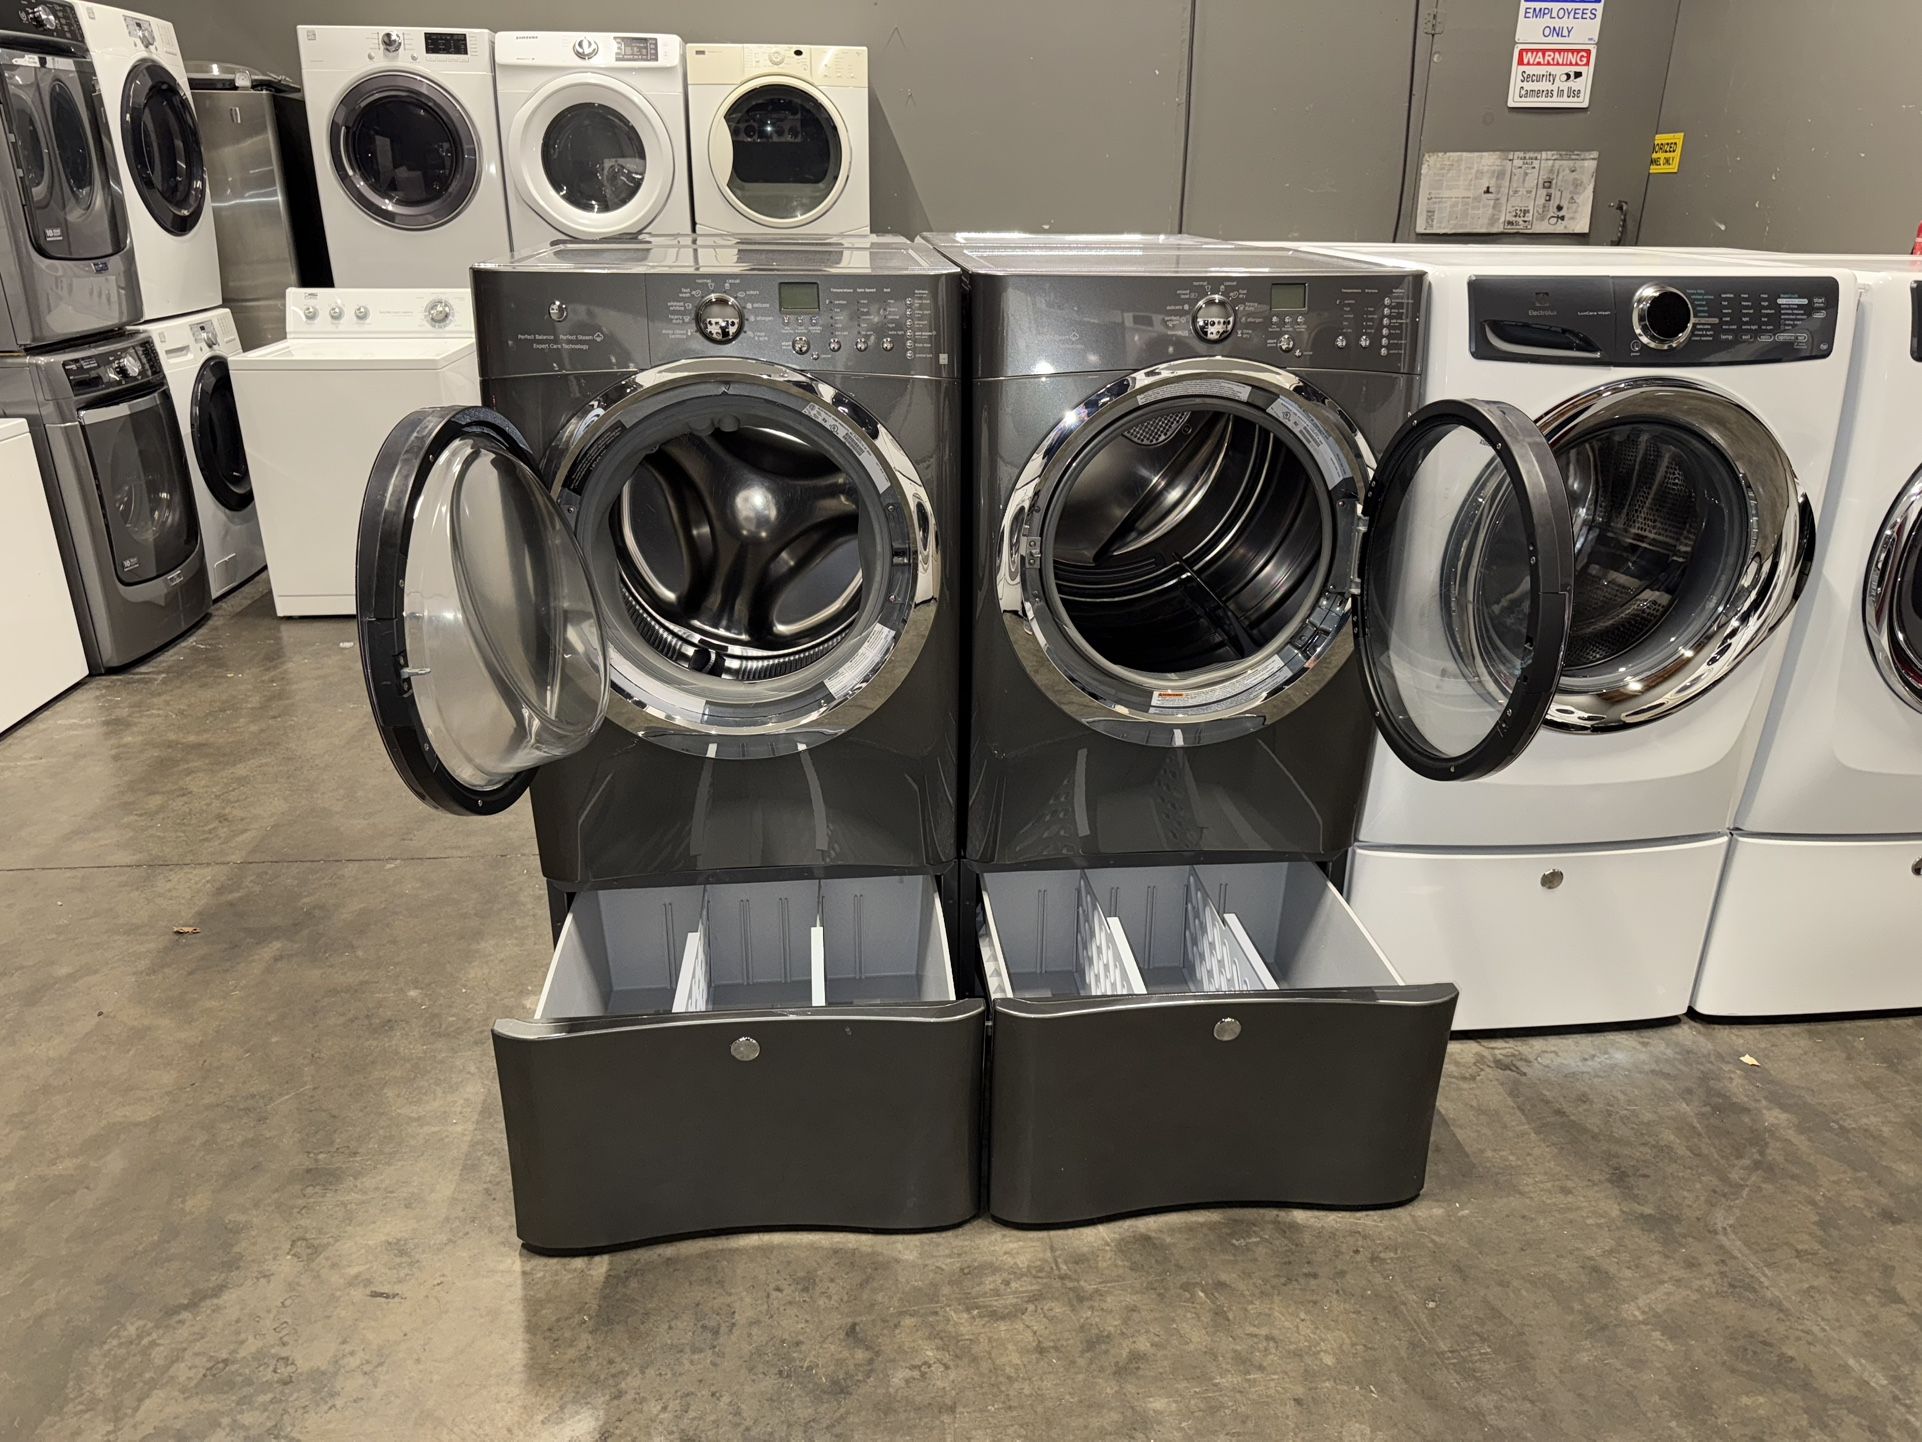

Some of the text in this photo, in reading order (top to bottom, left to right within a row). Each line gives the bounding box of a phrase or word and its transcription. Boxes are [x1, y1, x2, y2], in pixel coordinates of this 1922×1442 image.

[1523, 7, 1597, 20] EMPLOYEES
[1542, 25, 1573, 38] ONLY
[1522, 51, 1587, 65] WARNING
[1520, 70, 1557, 85] Security
[1518, 86, 1581, 98] Cameras In Use
